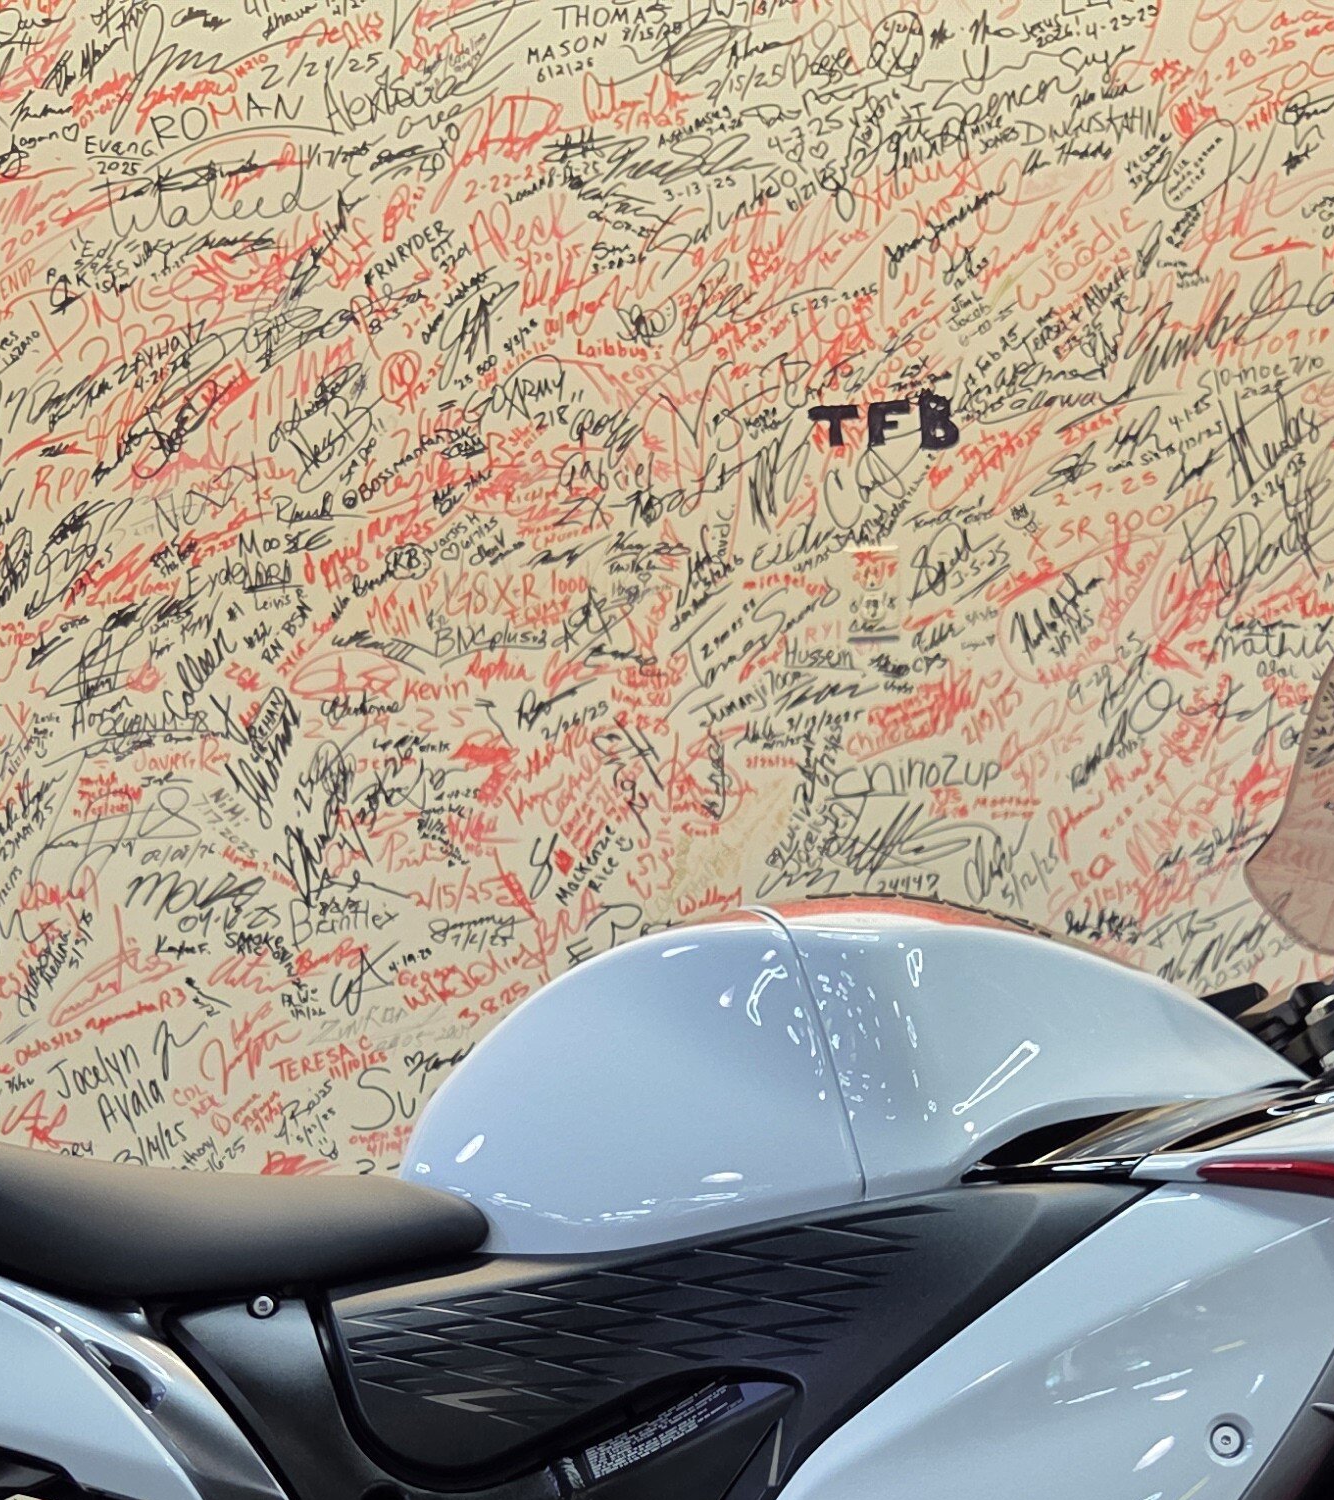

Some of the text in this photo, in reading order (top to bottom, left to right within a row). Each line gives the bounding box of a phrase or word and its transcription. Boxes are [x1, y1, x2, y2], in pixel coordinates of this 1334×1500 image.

[554, 4, 668, 30] THOMAS
[527, 34, 609, 65] MASON
[54, 1043, 142, 1100] Jocelyn
